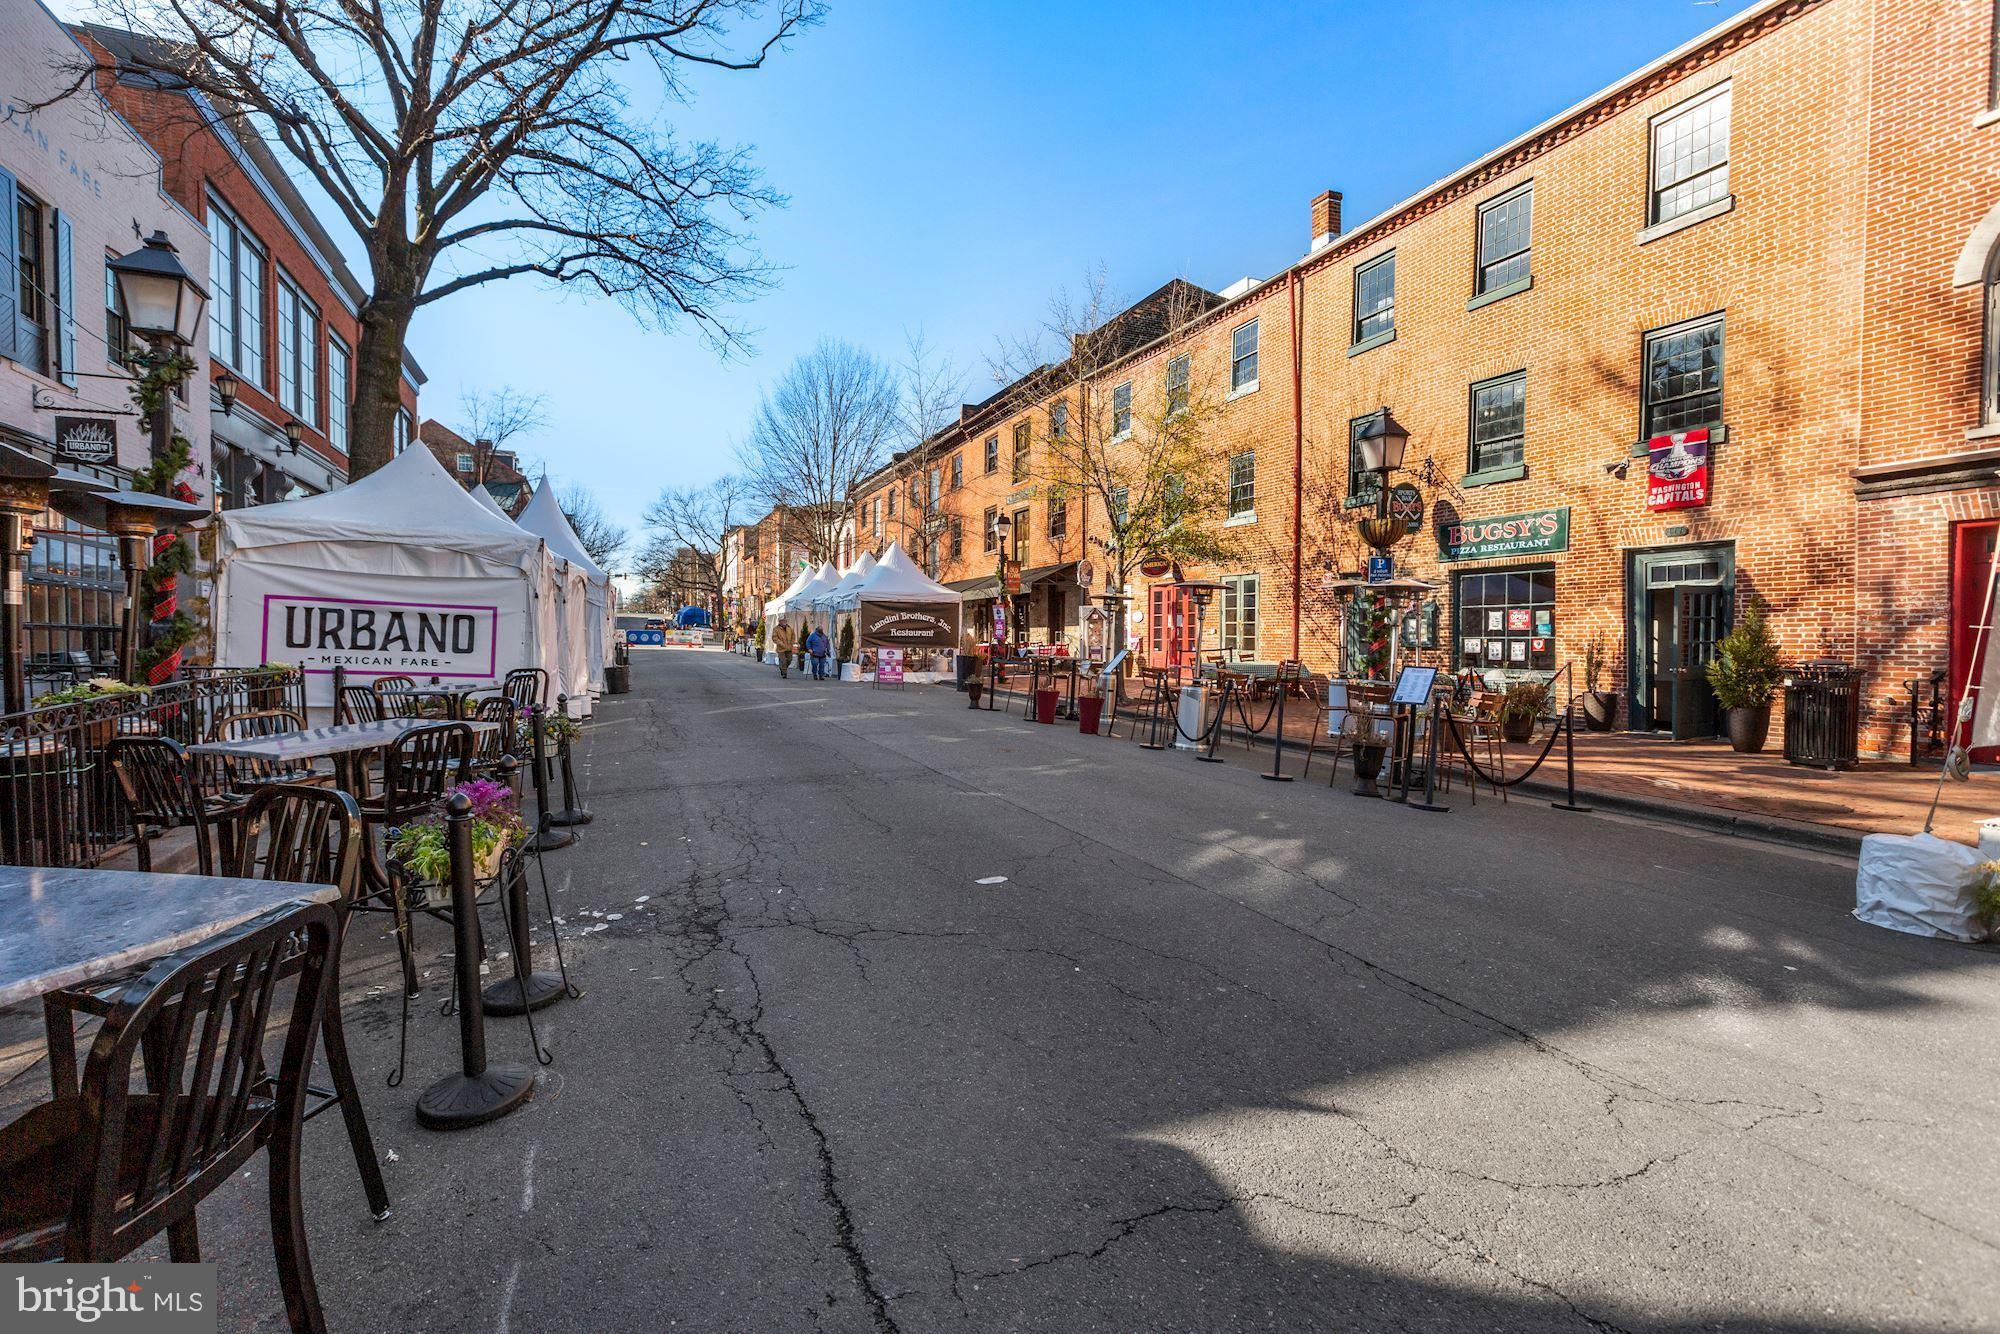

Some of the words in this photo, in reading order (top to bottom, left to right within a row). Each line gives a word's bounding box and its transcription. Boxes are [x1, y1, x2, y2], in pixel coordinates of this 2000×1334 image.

[68, 441, 101, 451] URBANO
[1648, 488, 1704, 506] CAPITALS
[1651, 481, 1701, 495] WASHINGTON
[1448, 513, 1558, 546] BUGSY'S
[1450, 546, 1478, 556] PIZZA
[1480, 538, 1551, 553] RESTAURANT
[285, 605, 476, 654] URBANO
[869, 612, 900, 633] Landini
[889, 628, 935, 637] Restaurant
[321, 655, 392, 665] MEXICAN
[401, 658, 438, 667] FARE
